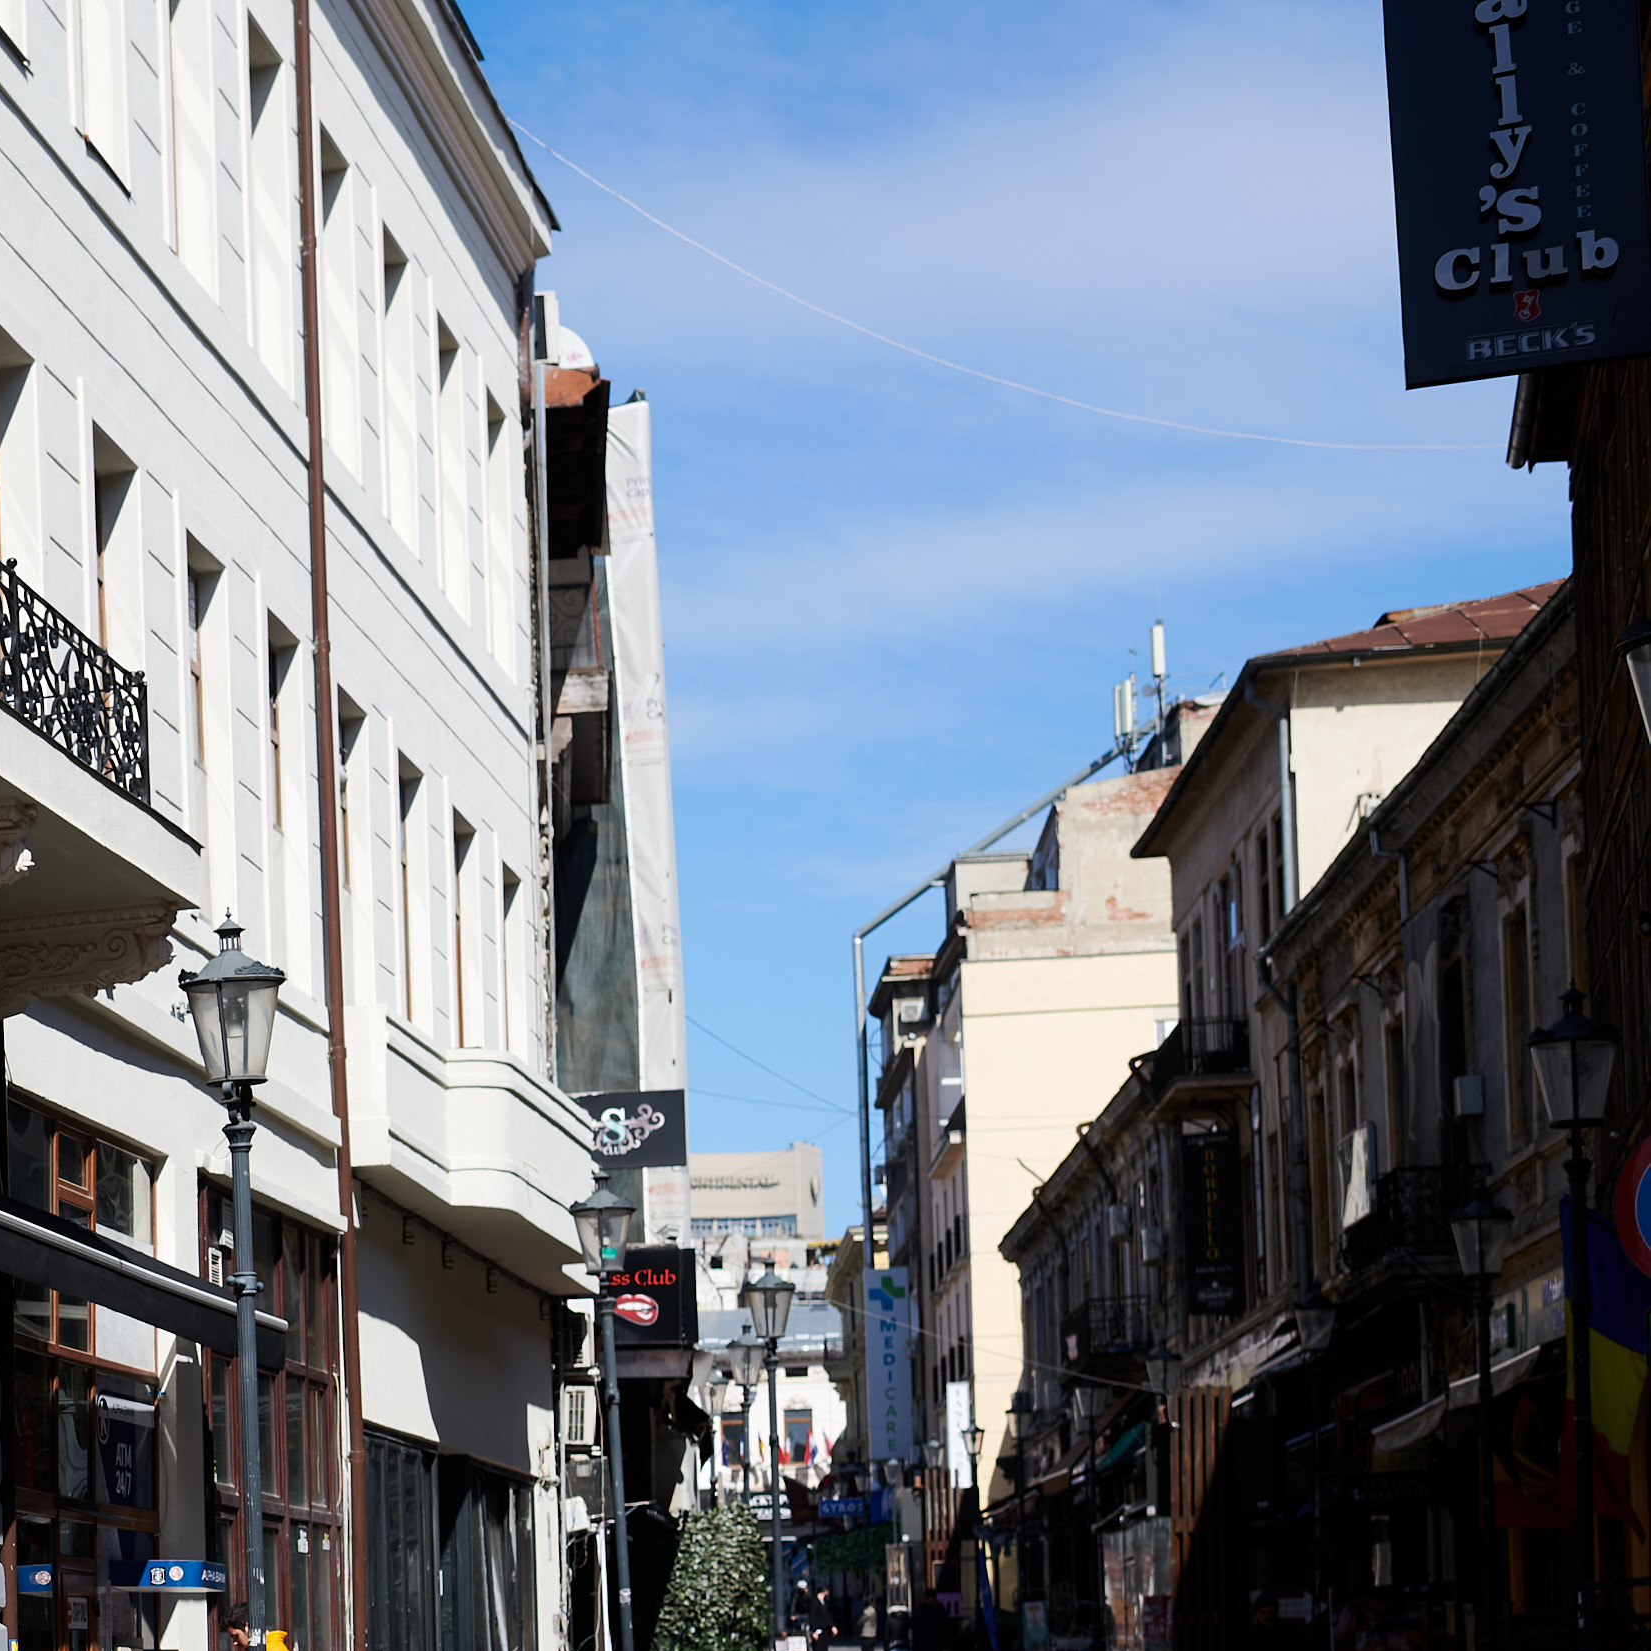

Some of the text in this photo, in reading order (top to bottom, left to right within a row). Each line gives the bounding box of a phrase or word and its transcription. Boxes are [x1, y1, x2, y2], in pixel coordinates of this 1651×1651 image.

[1570, 102, 1591, 219] COFFEE
[1434, 229, 1619, 291] Club
[1465, 321, 1596, 361] BECK'S
[634, 1268, 676, 1286] Club
[880, 1318, 897, 1453] MEDICARE
[115, 1442, 132, 1469] ATM
[115, 1470, 132, 1499] 24/7
[821, 1501, 865, 1514] GYROS
